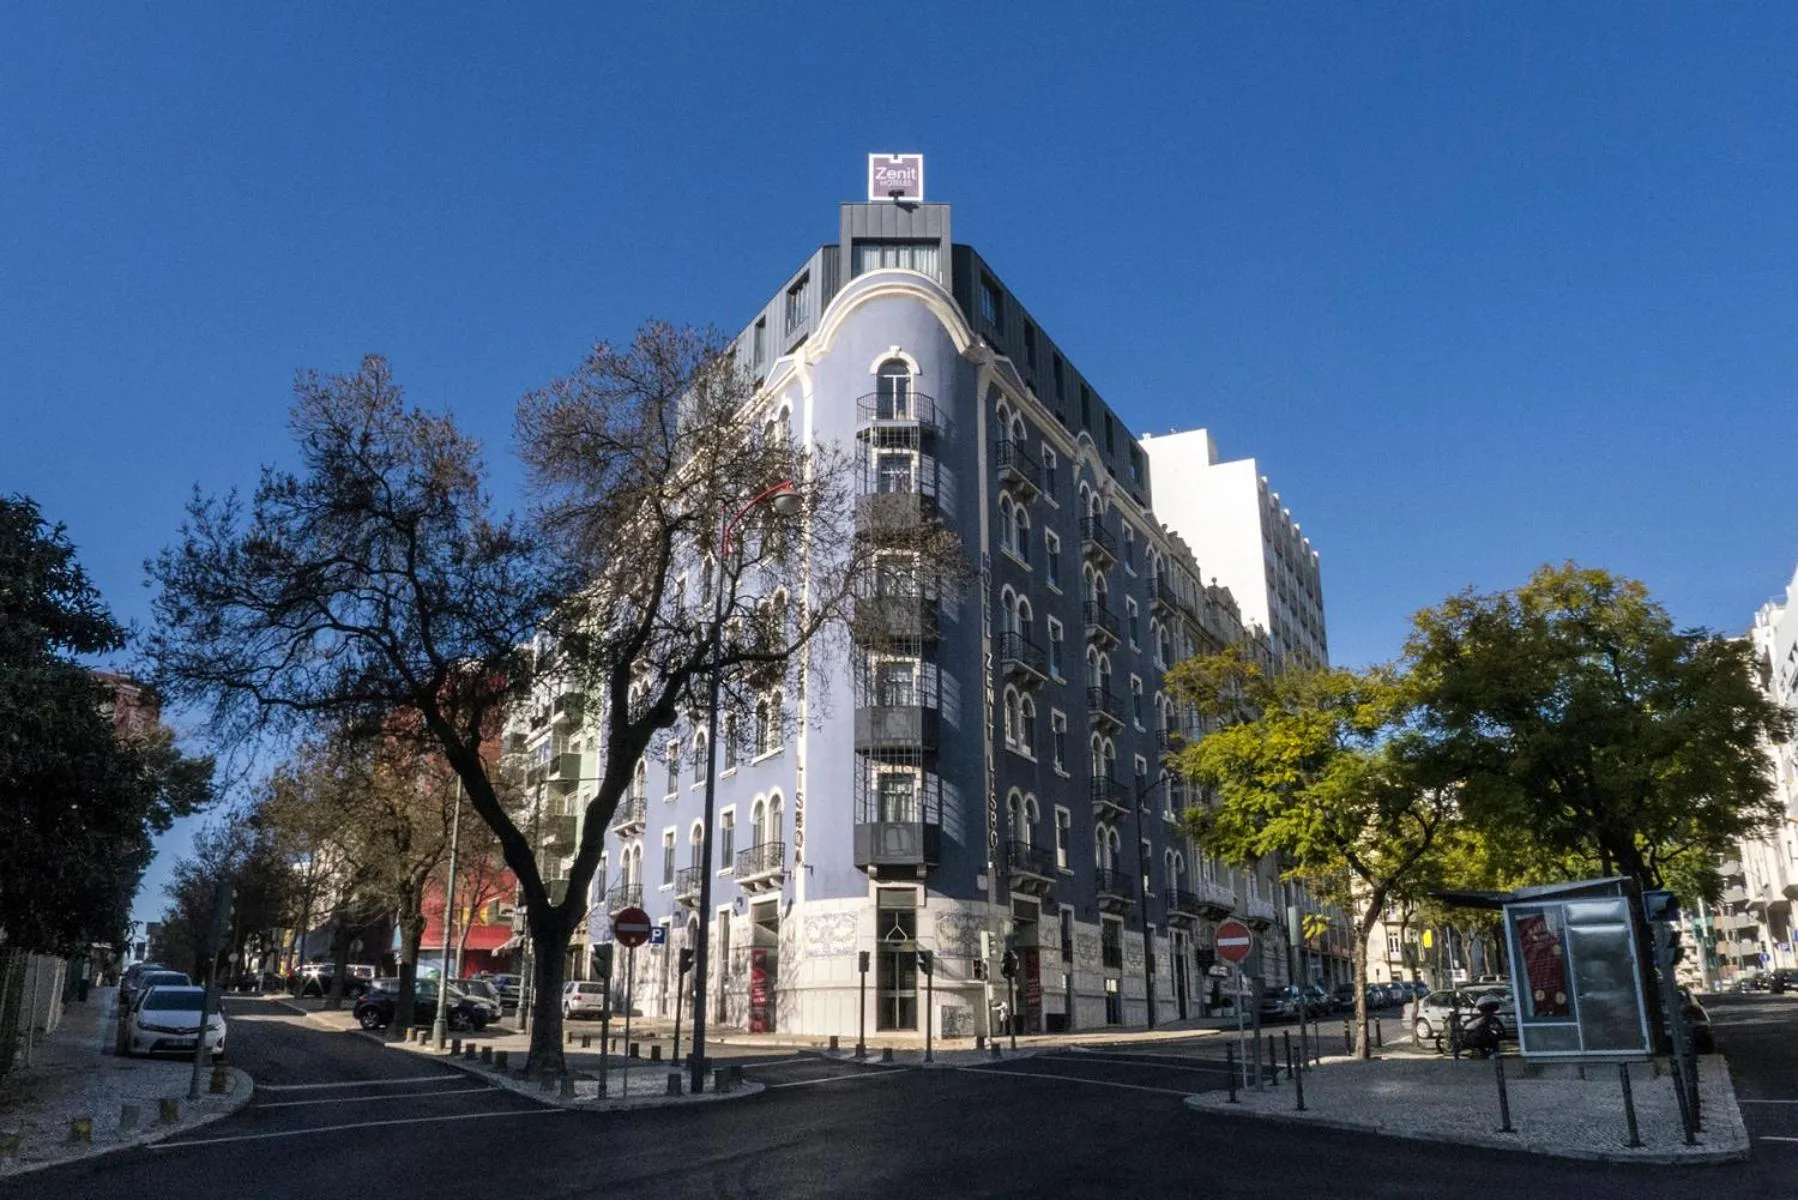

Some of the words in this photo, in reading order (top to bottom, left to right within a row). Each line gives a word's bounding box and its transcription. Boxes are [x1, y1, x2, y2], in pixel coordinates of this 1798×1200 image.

[875, 167, 917, 180] Zenit
[984, 652, 996, 741] ZENIT
[652, 928, 662, 941] P
